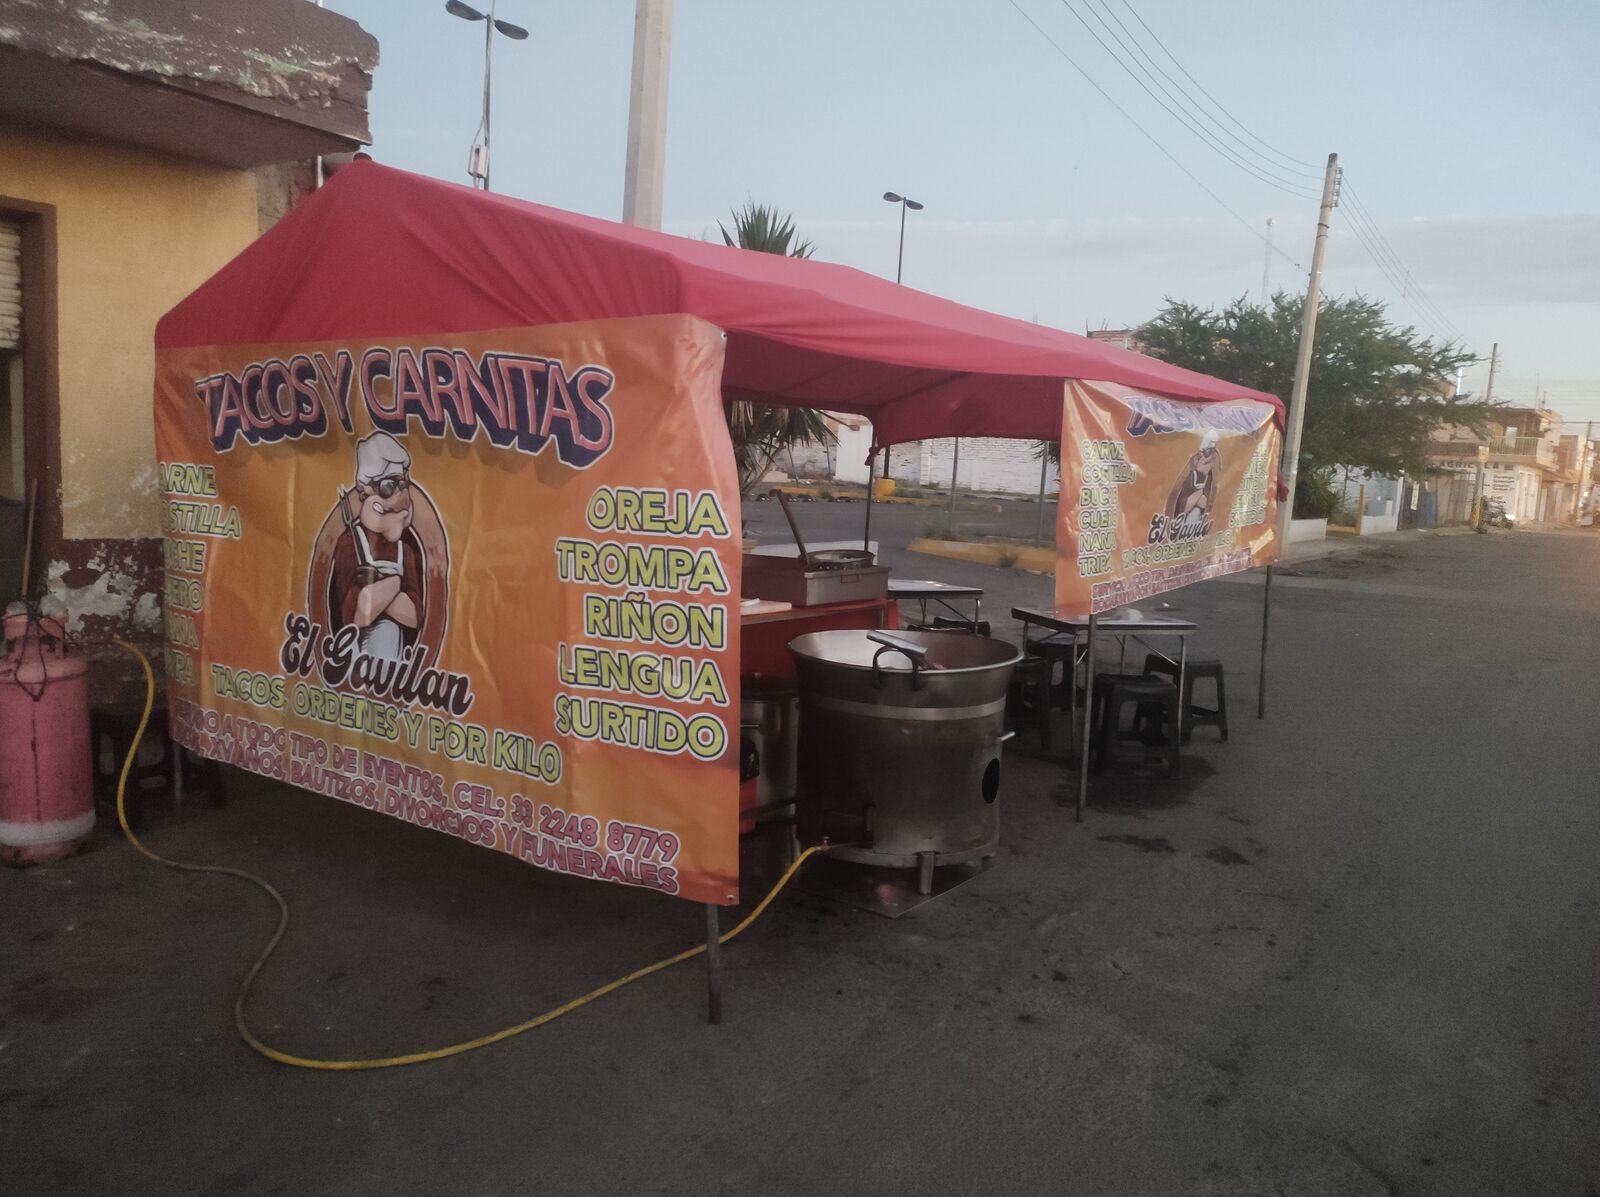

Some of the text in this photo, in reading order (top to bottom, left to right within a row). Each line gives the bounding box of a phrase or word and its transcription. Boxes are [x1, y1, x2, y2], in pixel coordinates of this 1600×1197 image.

[195, 346, 616, 471] TACOS Y CARNITAS
[163, 500, 242, 540] STILLA
[586, 486, 732, 540] OREJA
[1148, 513, 1168, 545] El
[555, 539, 732, 595] TROMPA
[584, 590, 728, 651] RIÑON
[279, 611, 476, 719] El Gavilan
[558, 643, 730, 707] LENGUA
[212, 663, 562, 784] TACOS ORDENES Y POR KILO
[554, 694, 729, 762] SURTIDO
[236, 716, 289, 755] TODO
[289, 730, 329, 766] TIPO
[332, 742, 358, 775] DE
[510, 793, 534, 830] 33
[538, 804, 600, 849] 2248
[606, 819, 680, 864] 8779
[383, 785, 496, 848] DIVORCIOS
[500, 821, 519, 854] Y
[519, 829, 681, 896] FUNERALES
